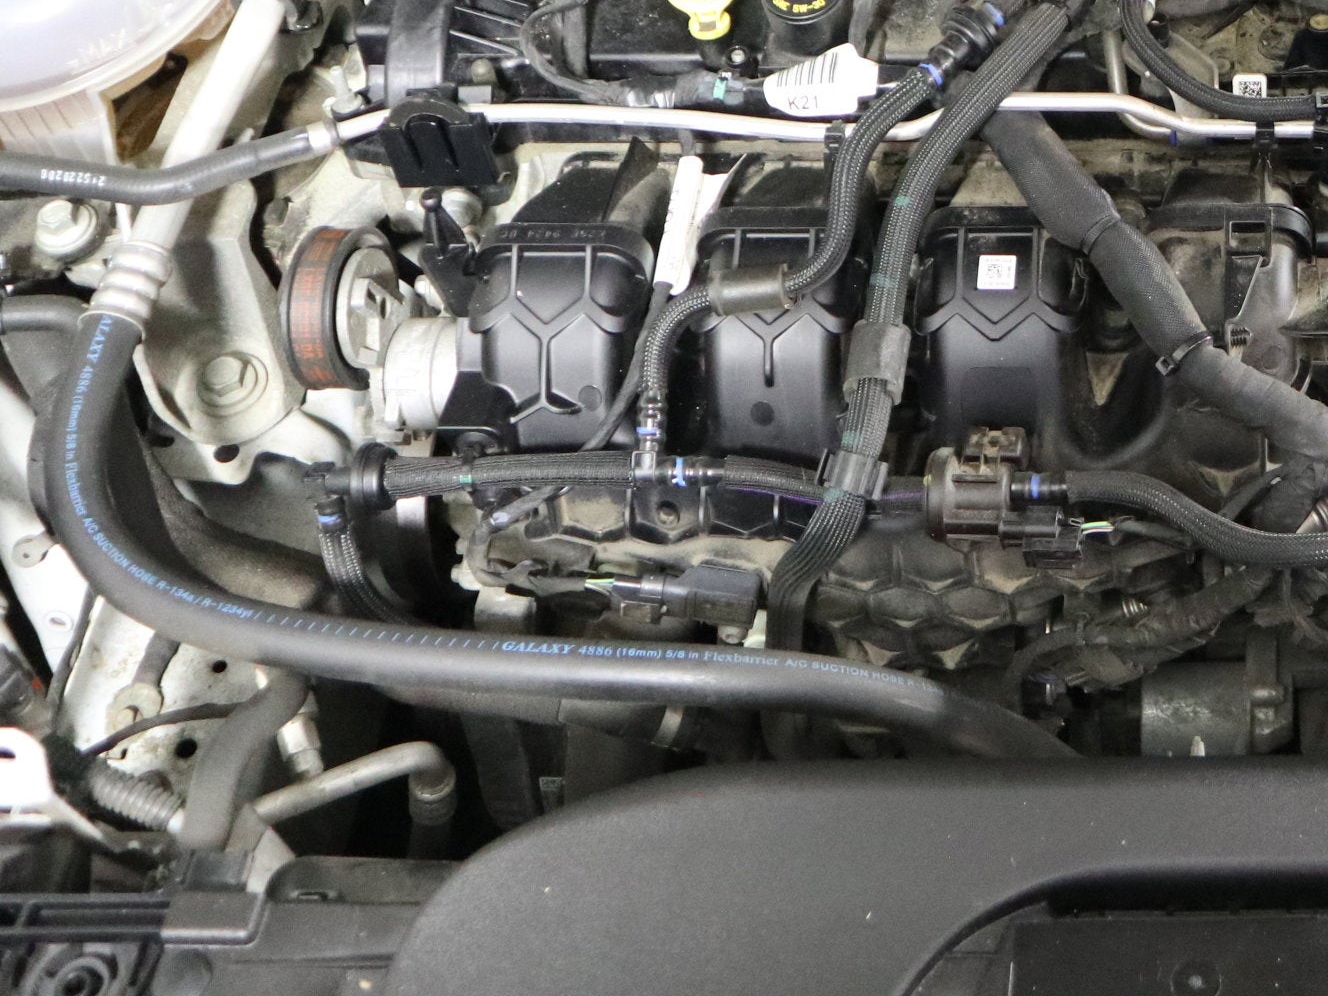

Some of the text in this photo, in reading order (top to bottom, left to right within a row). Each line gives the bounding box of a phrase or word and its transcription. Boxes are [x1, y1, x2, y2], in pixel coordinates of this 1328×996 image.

[788, 96, 818, 110] K21
[87, 314, 112, 363] ALAXY
[76, 365, 94, 394] 4886
[66, 395, 84, 431] (16mm)
[65, 433, 77, 451] 5/8
[64, 462, 88, 517] Flexbarrier
[83, 517, 98, 535] A/C
[92, 531, 132, 568] SUCTION
[127, 563, 156, 585] HOSE
[155, 579, 194, 603] R-134a
[502, 640, 576, 655] GALAXY
[578, 645, 613, 657] 4886
[616, 647, 661, 659] (16mm)
[666, 650, 685, 660] 5/8
[688, 651, 699, 660] in
[704, 651, 779, 666] Flexbarrier
[784, 659, 808, 670] A/C
[811, 661, 869, 679] SUCTION
[872, 671, 905, 686] HOSE
